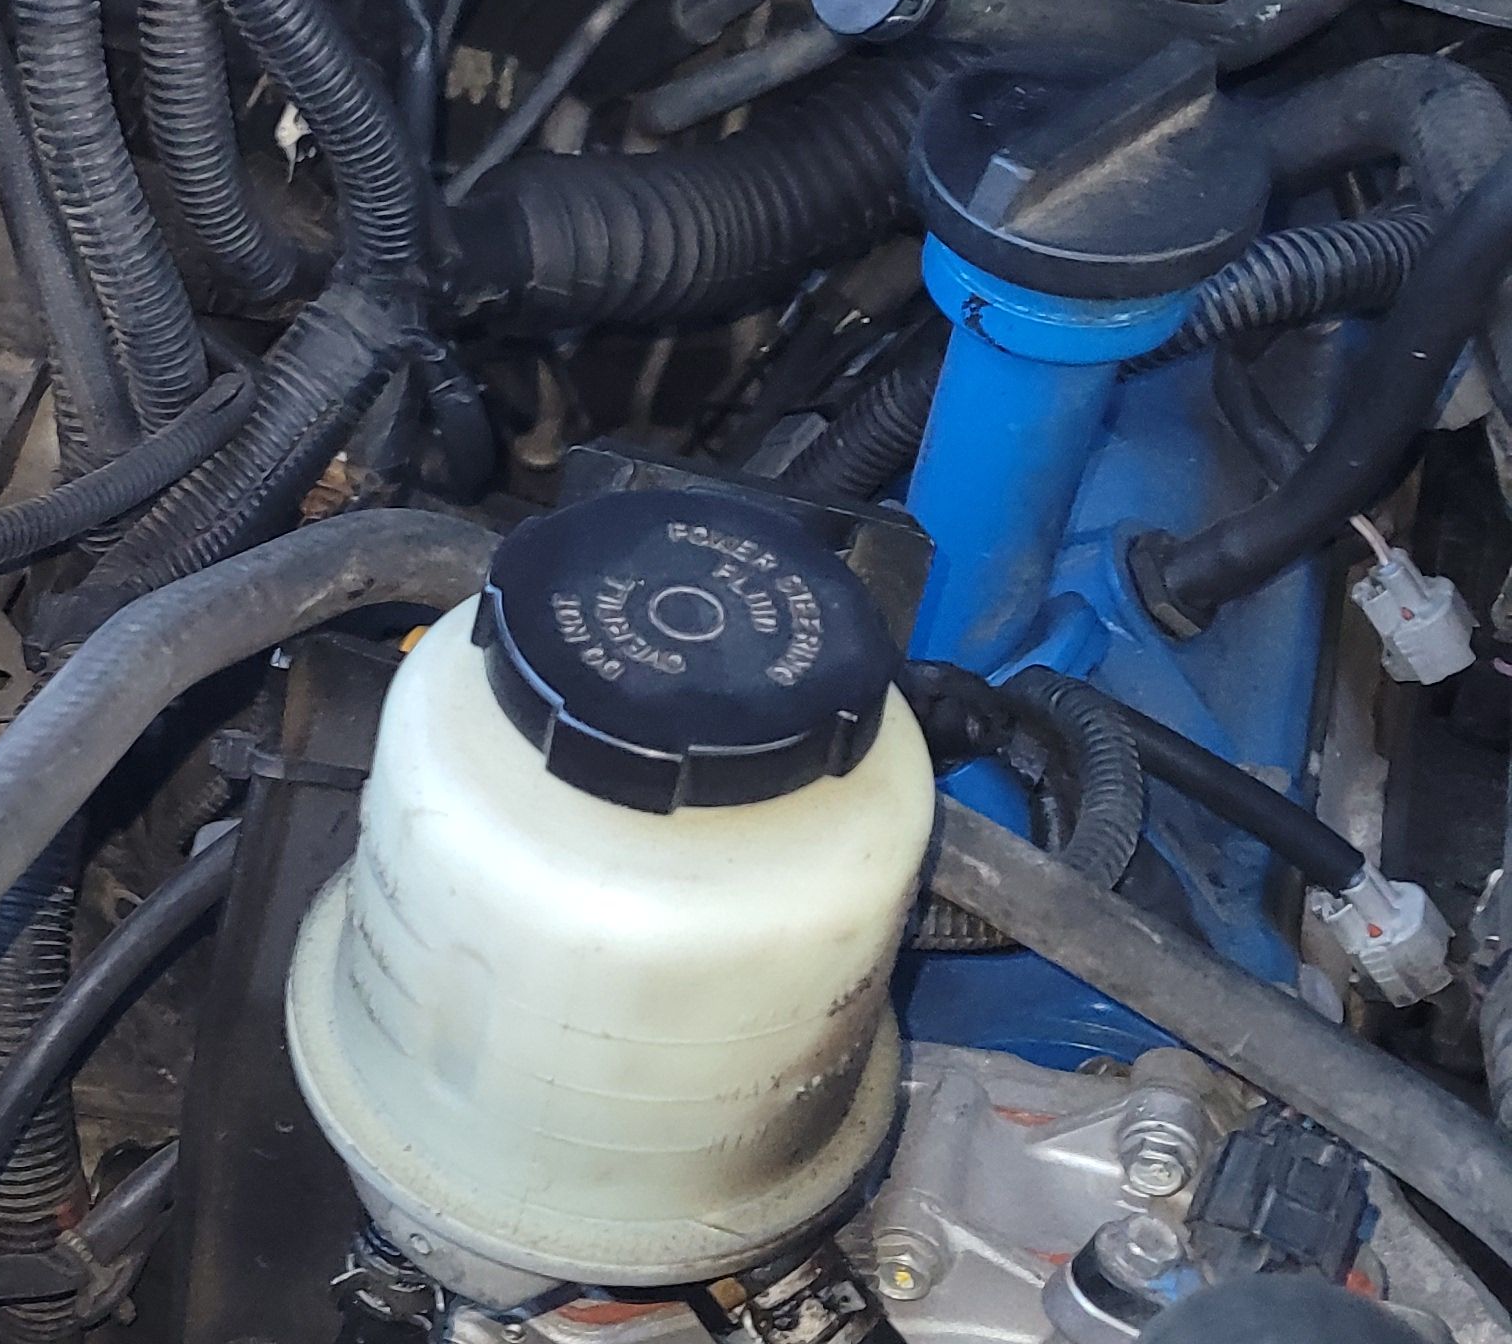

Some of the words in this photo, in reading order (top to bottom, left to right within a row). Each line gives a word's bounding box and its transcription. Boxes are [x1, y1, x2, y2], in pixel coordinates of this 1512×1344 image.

[550, 591, 592, 644] NOT
[711, 561, 778, 635] FLUID
[580, 643, 626, 683] DO
